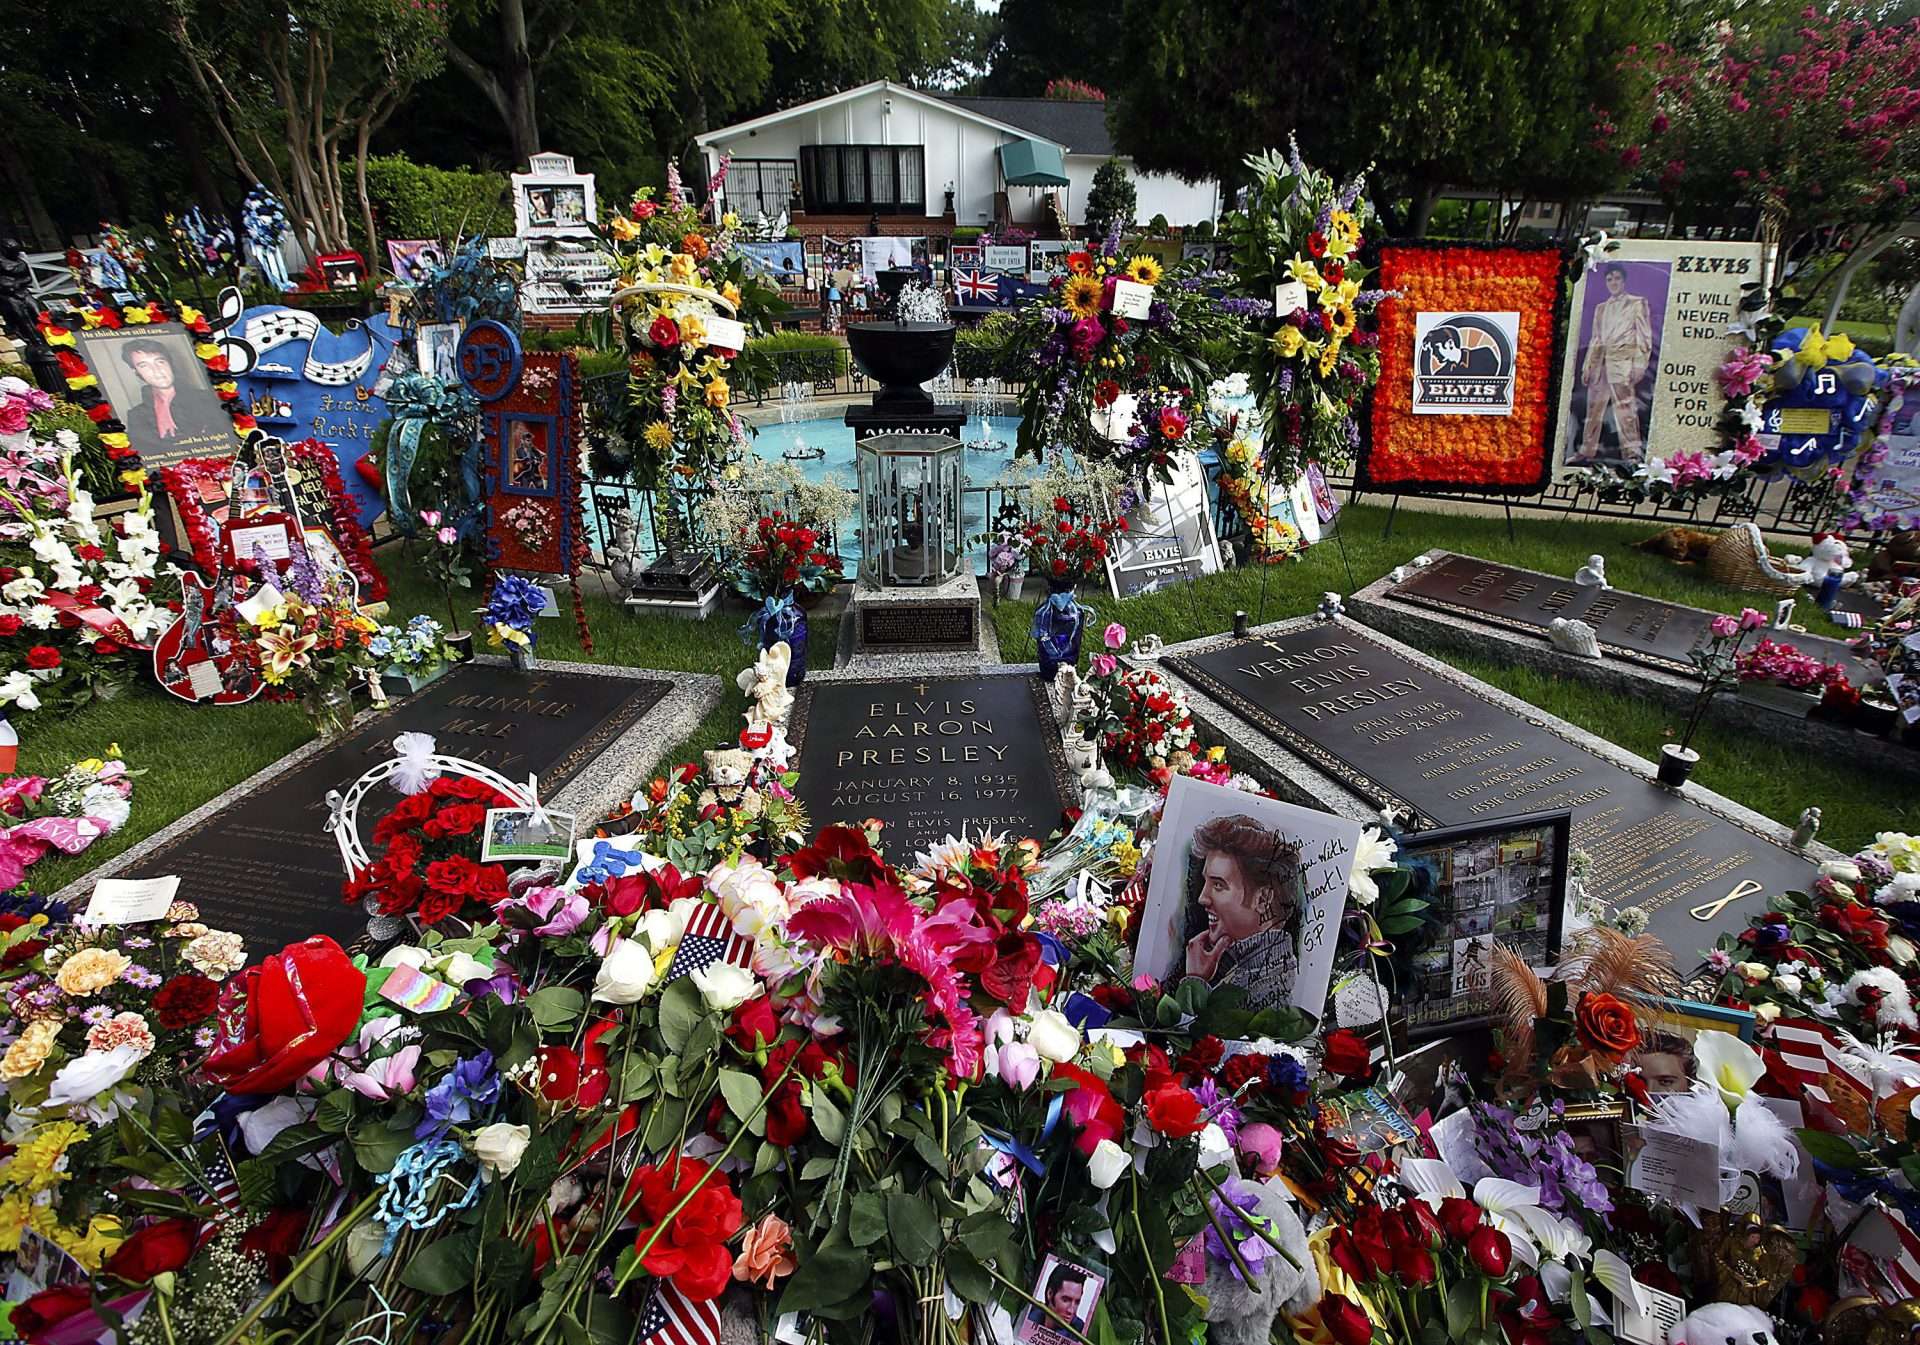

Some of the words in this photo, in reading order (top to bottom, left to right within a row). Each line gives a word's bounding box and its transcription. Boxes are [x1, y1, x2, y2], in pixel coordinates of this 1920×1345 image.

[1677, 255, 1751, 274] ELVIS
[1677, 292, 1691, 305] IT
[1698, 292, 1732, 306] WILL
[1677, 309, 1730, 324] NEVER
[1664, 362, 1696, 377] OUR
[1428, 384, 1497, 397] ELVIS
[1669, 381, 1709, 395] LOVE
[1434, 396, 1494, 404] INSIDERS
[1674, 397, 1707, 412] FOR
[1676, 413, 1713, 428] YOU!
[300, 480, 322, 494] HELP
[1144, 545, 1182, 561] ELVIS
[1145, 568, 1157, 577] We
[1237, 641, 1361, 681] VERNON
[1289, 663, 1371, 695] ELVIS
[446, 693, 577, 718] MINNIE
[1300, 676, 1424, 721] PRESLEY
[869, 699, 976, 718] ELVIS
[437, 718, 519, 739] MAE
[854, 719, 994, 739] AARON
[1352, 715, 1395, 735] APRIL
[1366, 725, 1409, 746] JUNE
[836, 744, 1009, 768] PRESLEY
[1413, 749, 1445, 766] JESSE
[1454, 731, 1495, 751] PRESLEY
[1420, 761, 1462, 782] MINNIE
[1484, 739, 1524, 760] PRESLEY
[832, 776, 936, 792] JANUARY
[973, 774, 1018, 786] 1935
[1447, 783, 1482, 801] ELVIS
[1482, 770, 1519, 789] AARON
[1518, 756, 1559, 776] PRESLEY
[831, 791, 926, 807] AUGUST
[975, 788, 1020, 800] 1977
[1467, 796, 1505, 816] JESSIE
[1504, 782, 1545, 801] GARON
[1543, 766, 1585, 786] PRESLEY
[1570, 785, 1612, 808] PRESLEY
[907, 818, 951, 828] ELVIS
[1455, 970, 1488, 991] ELVIS
[1455, 999, 1491, 1017] Elvis
